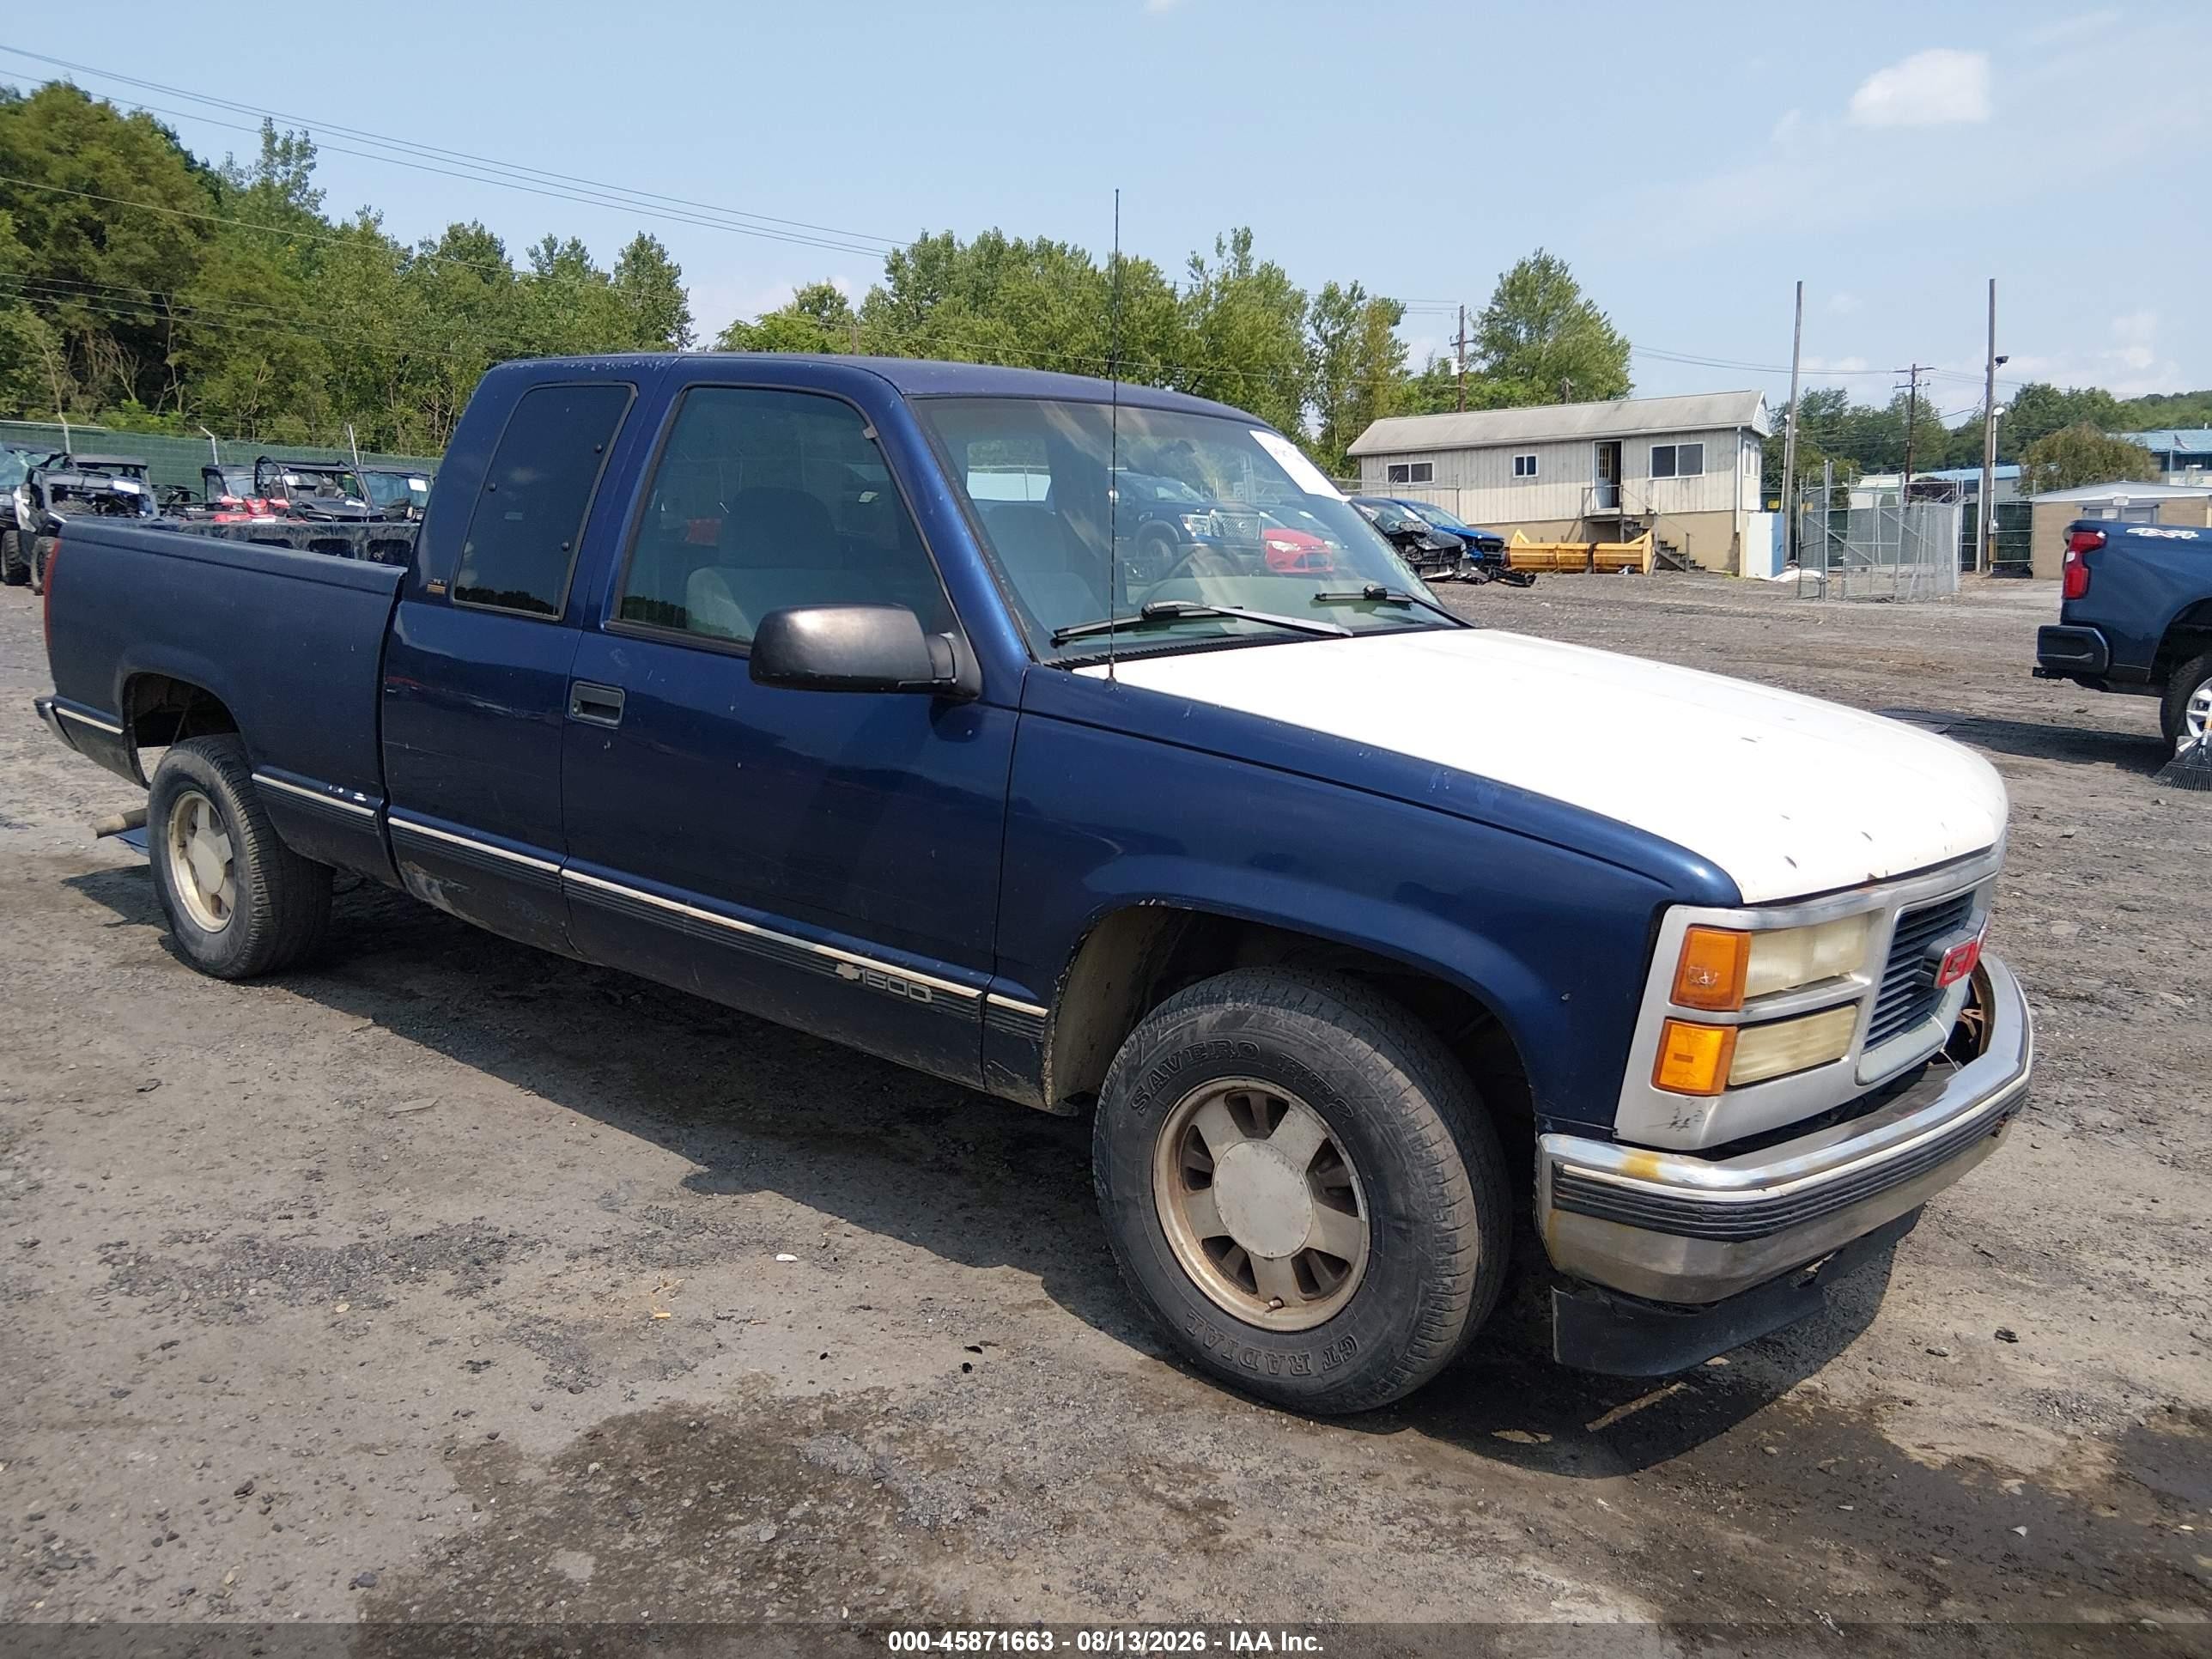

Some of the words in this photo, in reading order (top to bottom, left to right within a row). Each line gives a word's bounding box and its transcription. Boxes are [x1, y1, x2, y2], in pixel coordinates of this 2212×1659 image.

[859, 969, 933, 1003] 1500
[1131, 1039, 1261, 1115] SAVERO
[1186, 1311, 1311, 1376] RADIAL
[1322, 1334, 1359, 1371] GT
